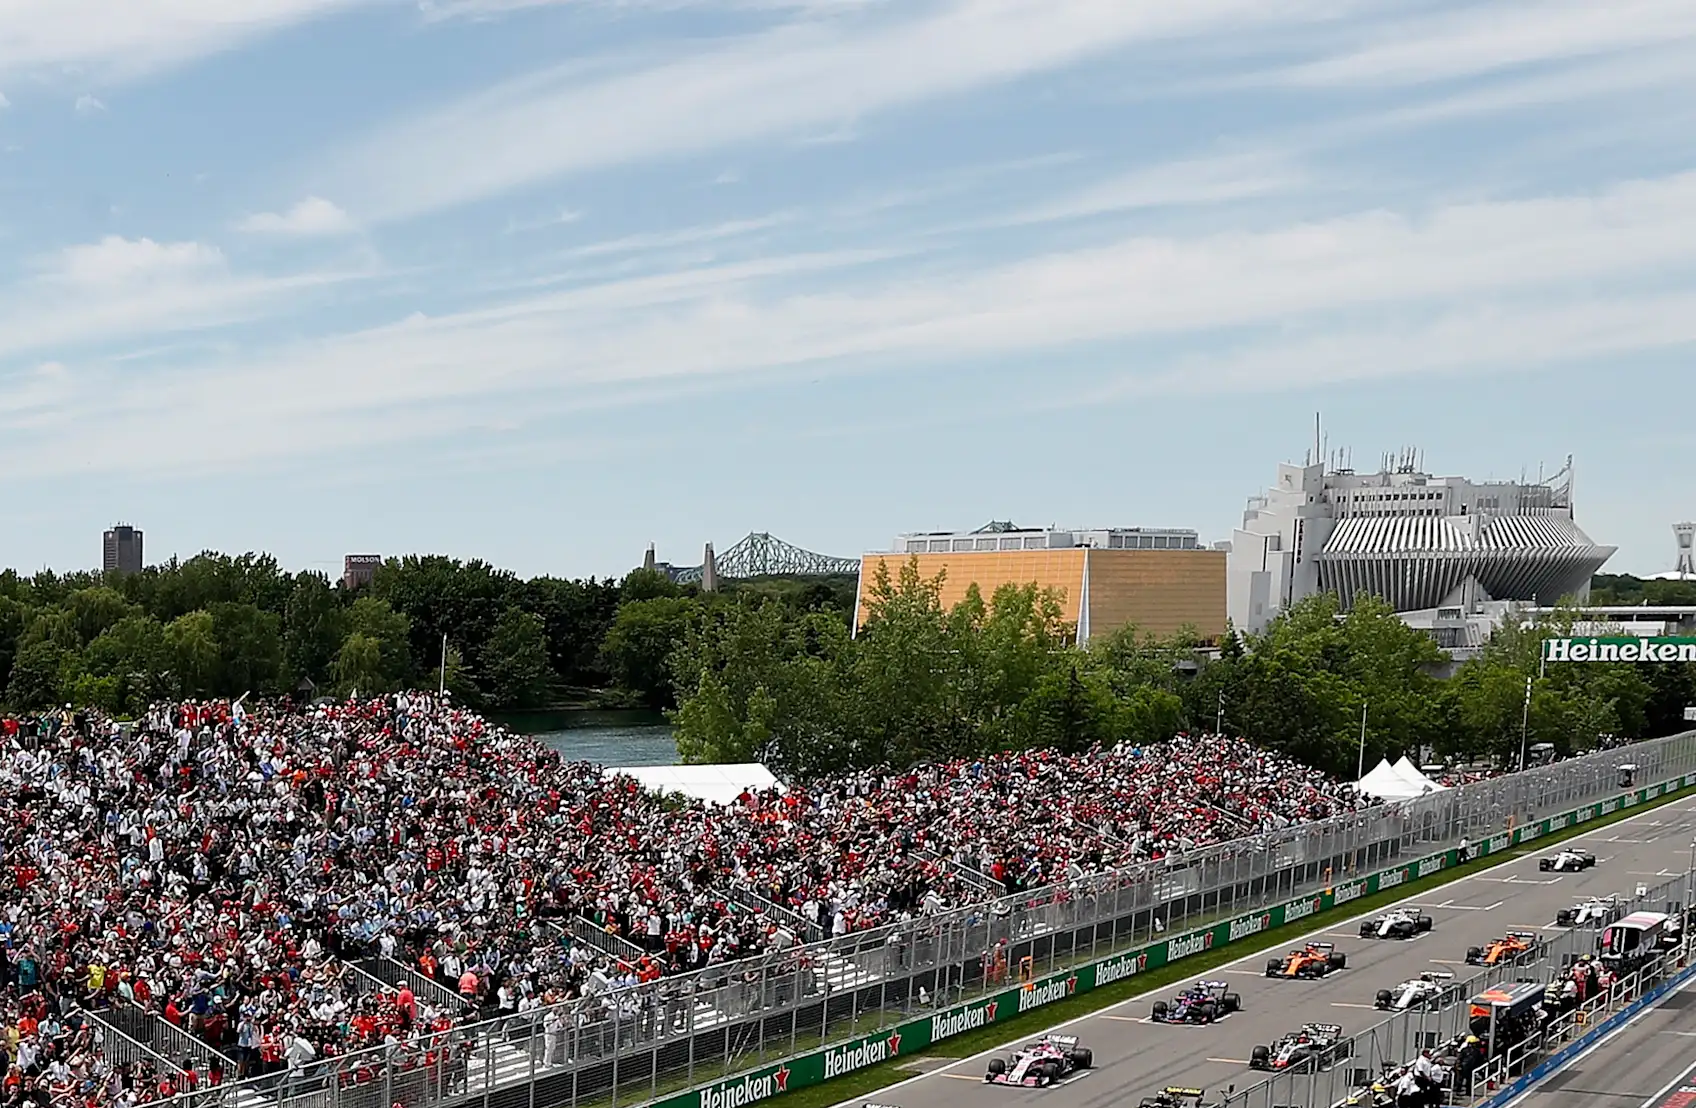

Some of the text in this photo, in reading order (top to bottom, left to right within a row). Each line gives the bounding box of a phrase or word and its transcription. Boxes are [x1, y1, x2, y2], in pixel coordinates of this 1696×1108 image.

[1546, 638, 1696, 662] Heineken
[1229, 915, 1262, 941] Heineken
[1167, 932, 1205, 962] Heineken
[1095, 955, 1137, 987] Heineken
[1018, 978, 1067, 1012] Heineken
[931, 1005, 985, 1043] Heineken
[824, 1038, 887, 1079] Heineken
